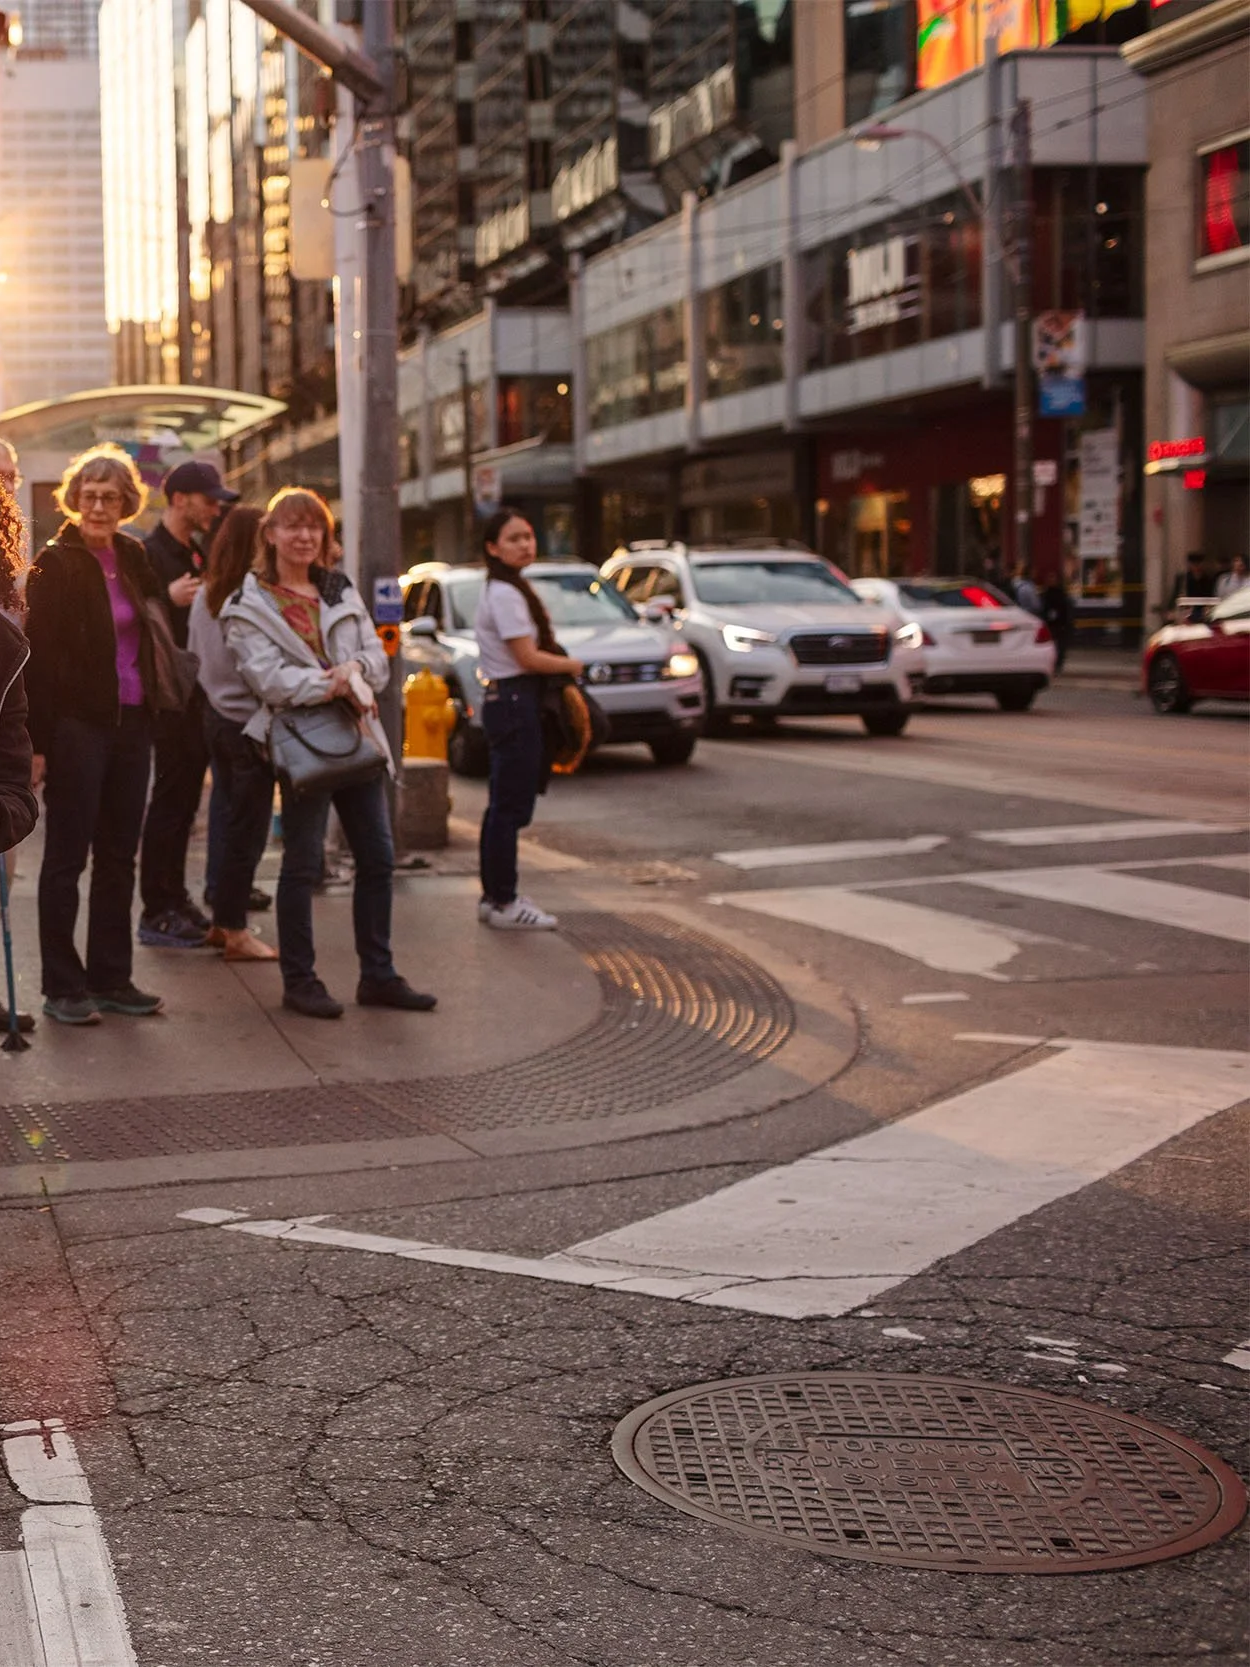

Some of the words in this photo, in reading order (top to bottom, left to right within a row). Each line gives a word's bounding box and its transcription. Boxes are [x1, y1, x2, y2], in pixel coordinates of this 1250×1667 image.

[815, 1438, 998, 1457] TORONTO
[762, 1453, 881, 1470] HYDRO
[889, 1457, 1076, 1475] ELECTRIC
[841, 1472, 1012, 1491] SYSTEM
